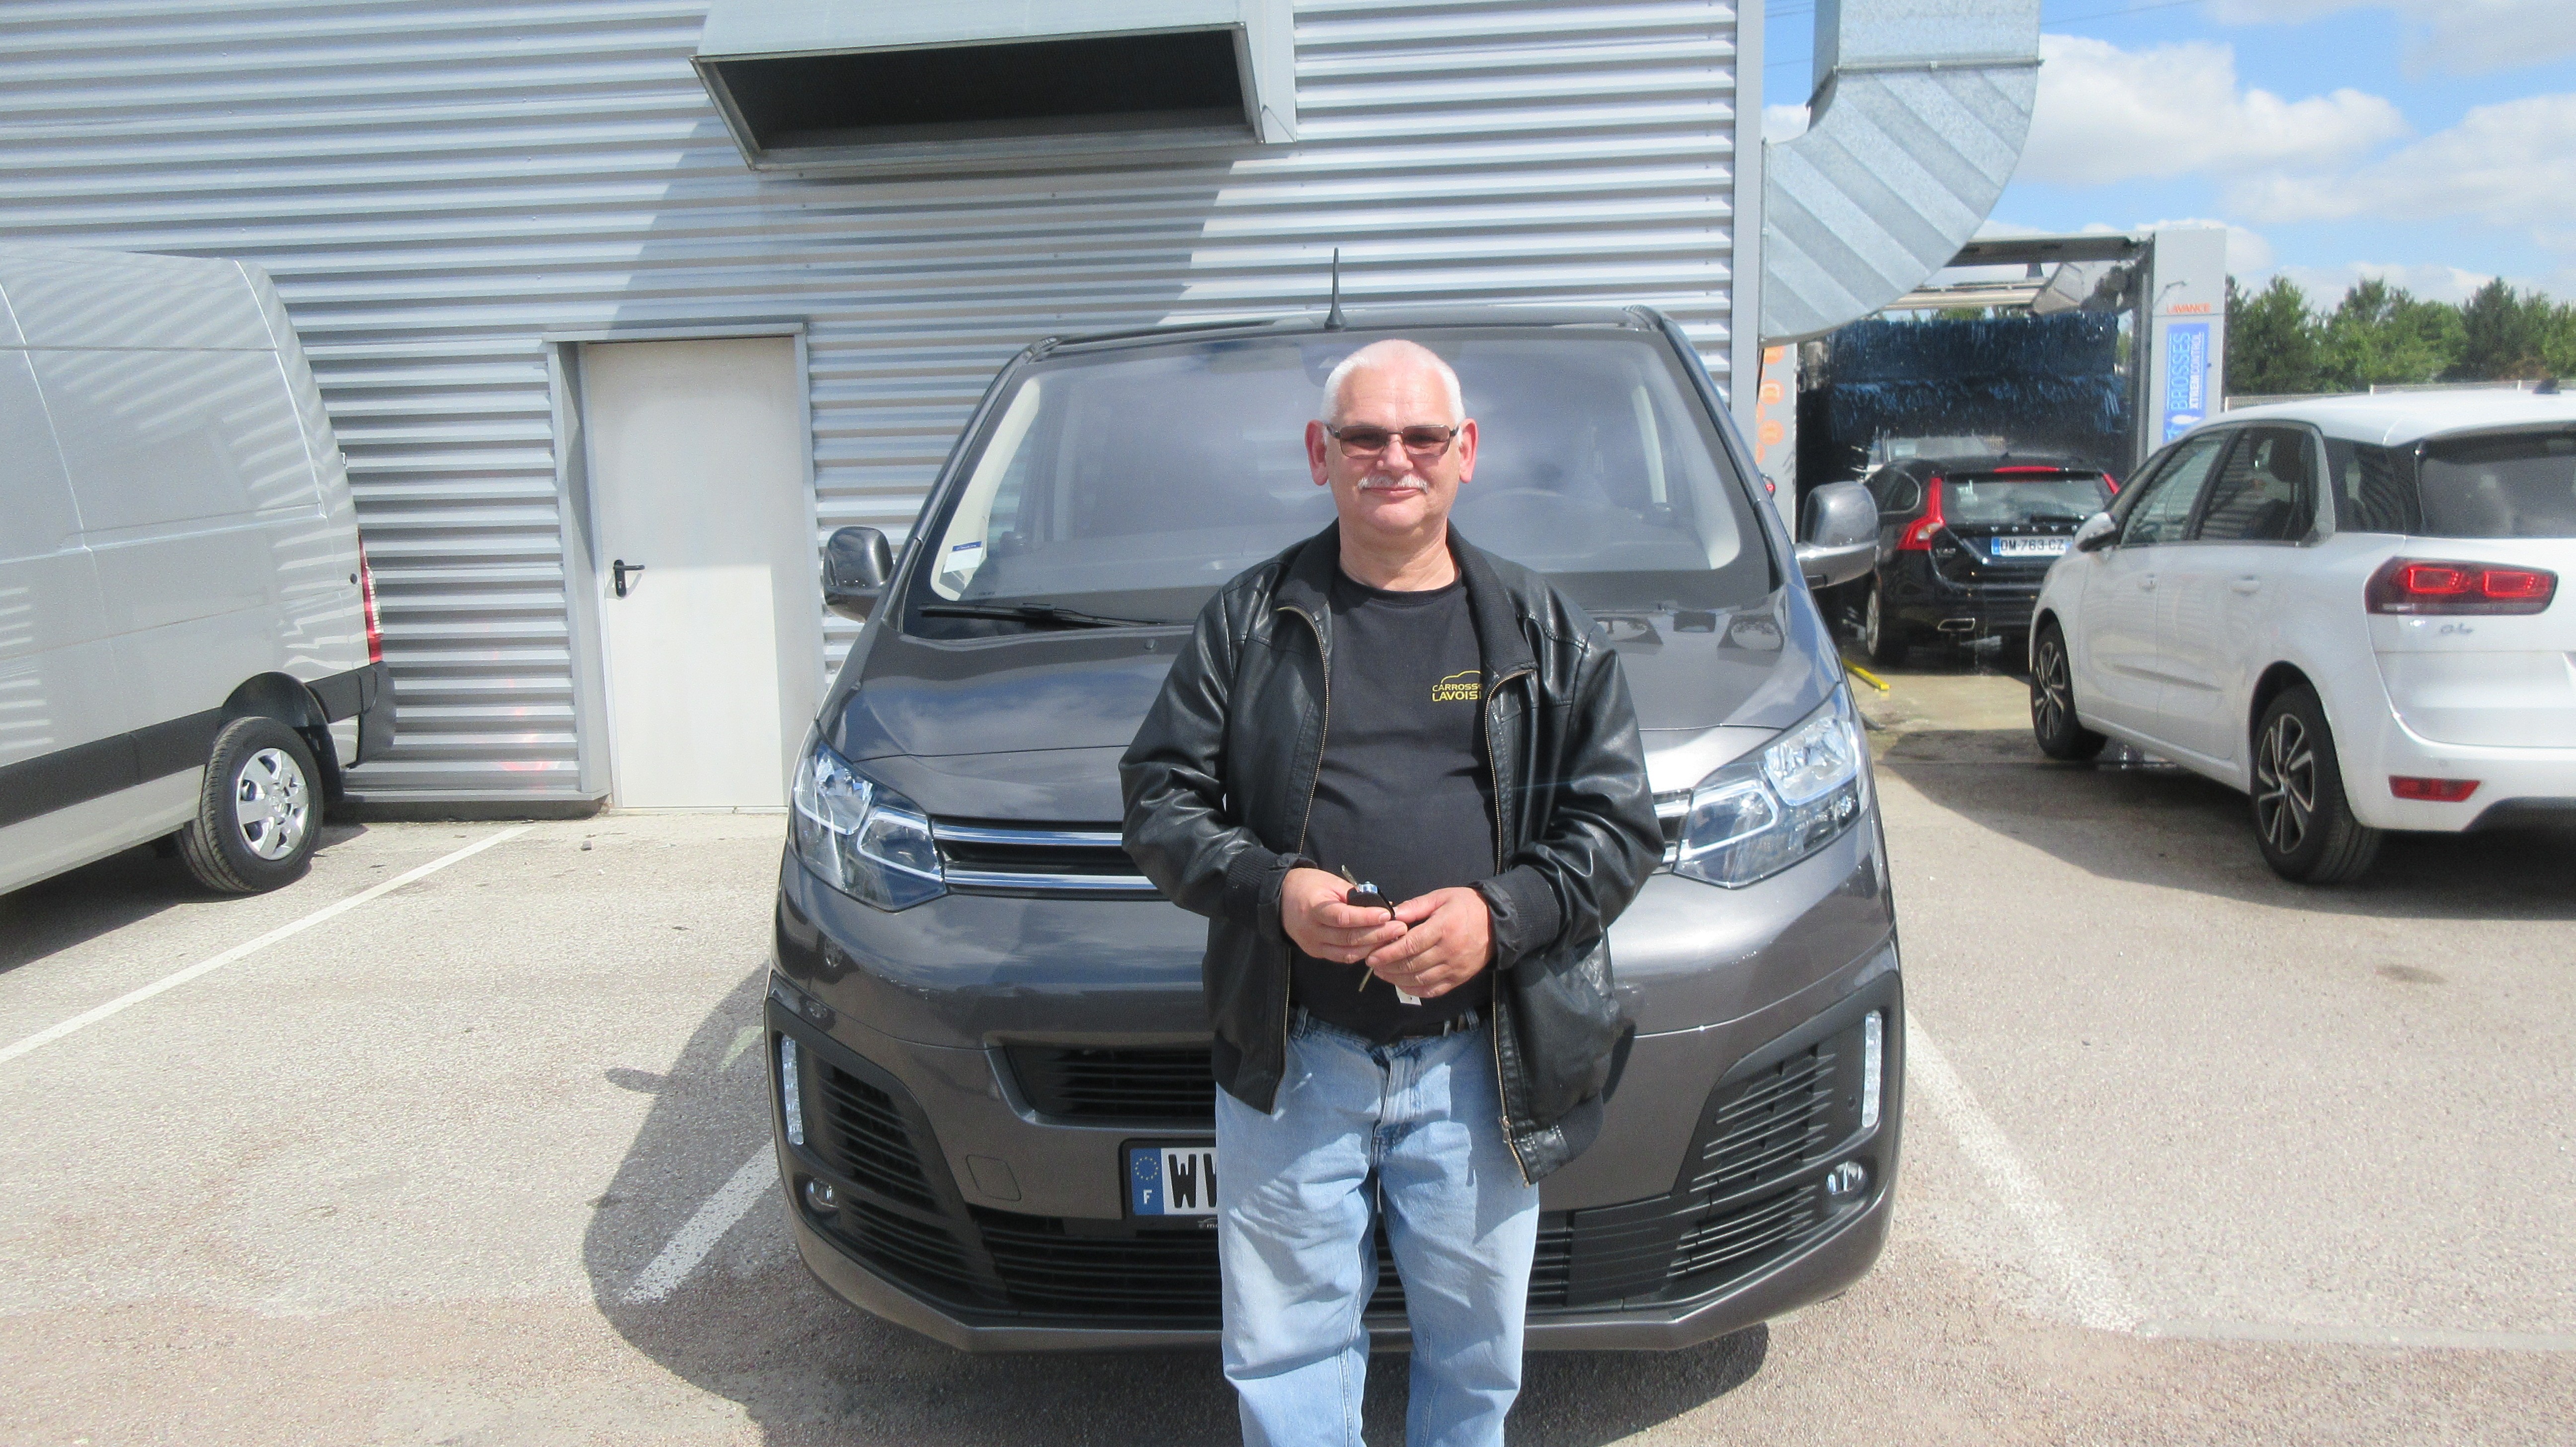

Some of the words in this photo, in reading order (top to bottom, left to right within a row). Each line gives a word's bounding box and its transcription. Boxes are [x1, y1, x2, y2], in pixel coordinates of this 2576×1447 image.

[2167, 303, 2210, 314] LAVANCE
[2171, 332, 2191, 410] BROSSES
[1143, 1190, 1152, 1204] F
